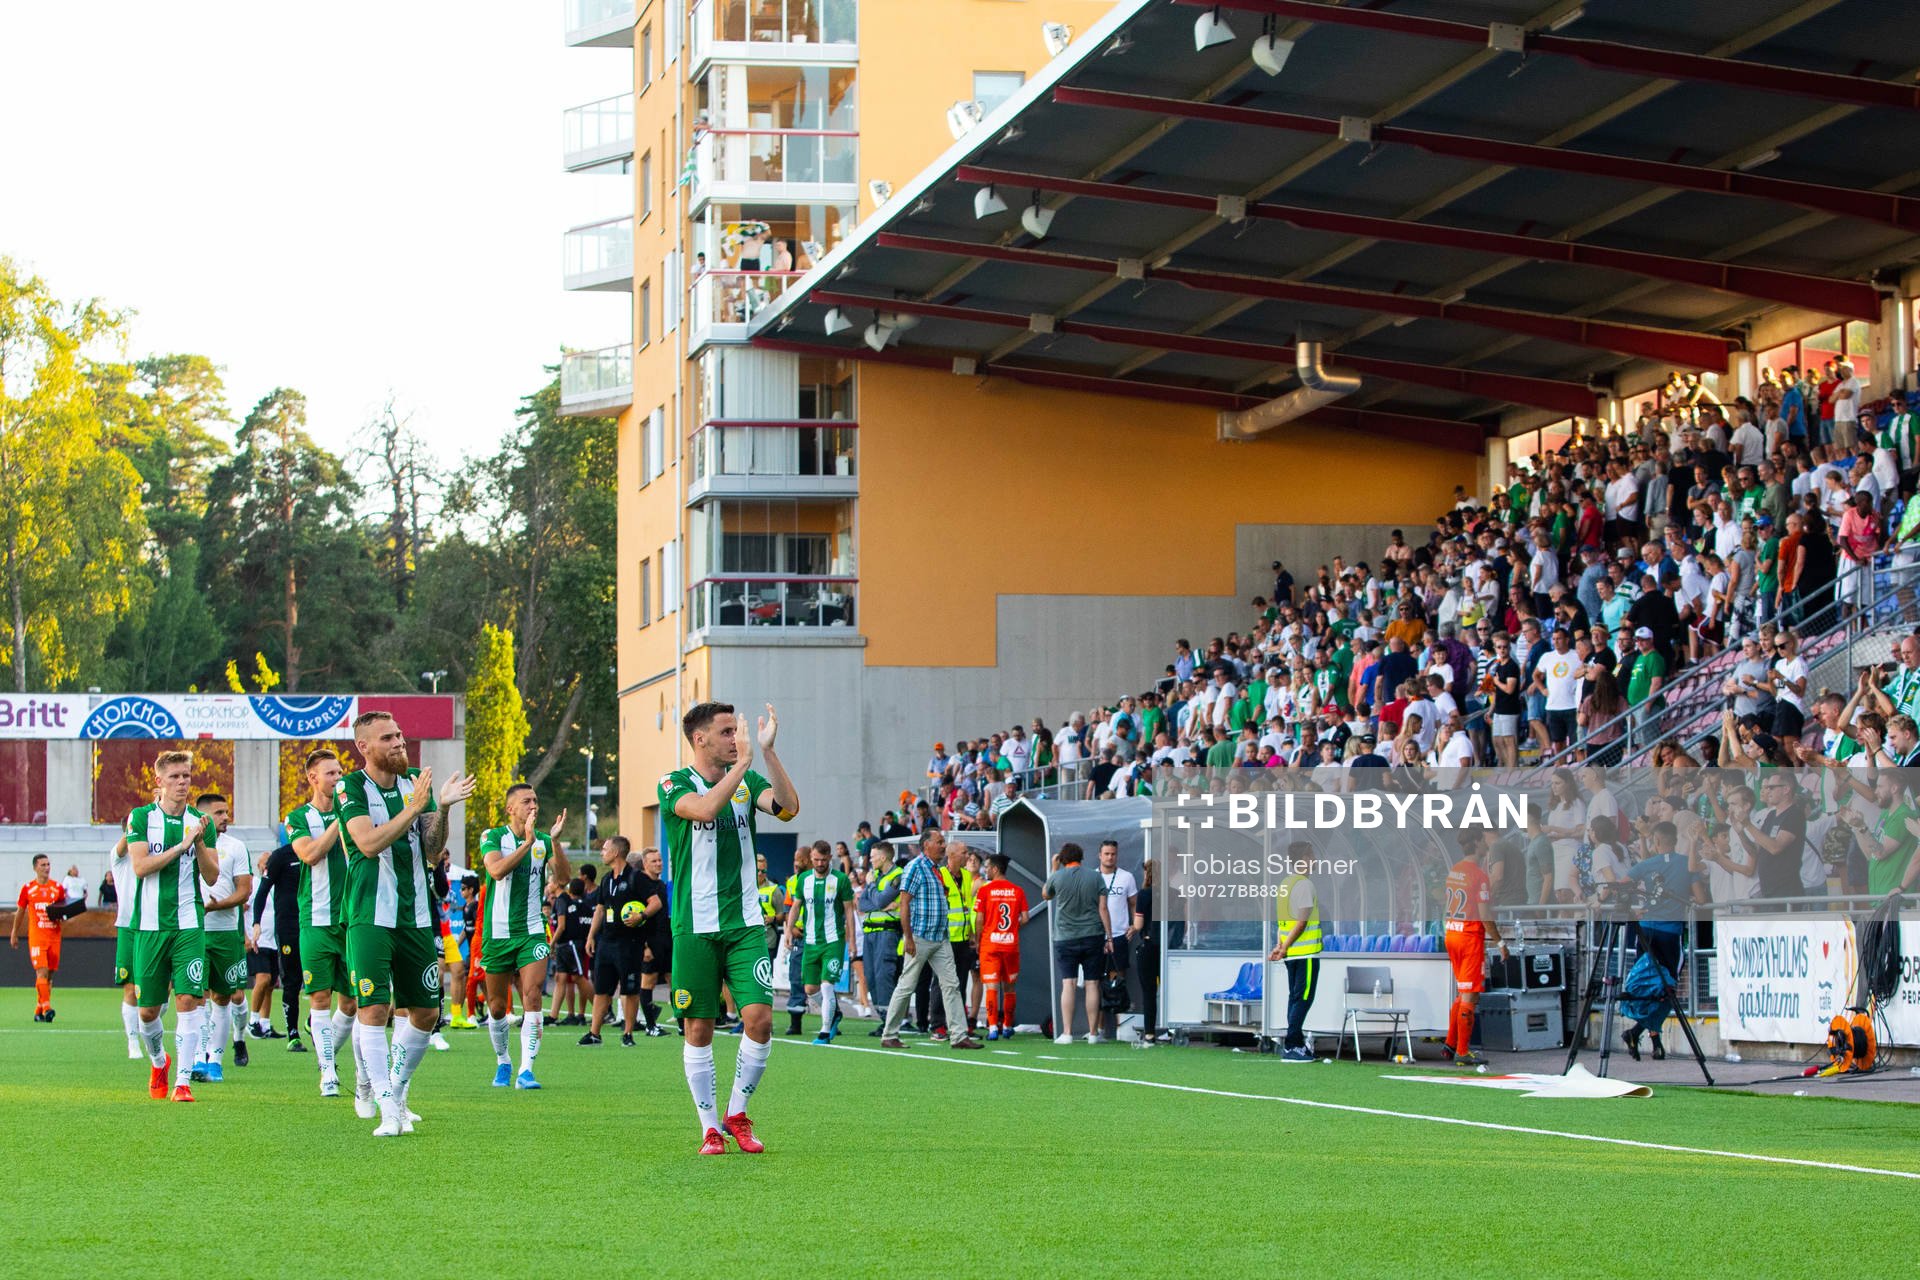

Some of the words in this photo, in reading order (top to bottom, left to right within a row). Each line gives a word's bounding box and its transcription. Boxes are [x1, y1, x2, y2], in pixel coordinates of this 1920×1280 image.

[87, 701, 177, 738] CHOPCHOP
[185, 706, 249, 719] CHOPCHOP
[254, 696, 294, 730] ASIAN
[998, 902, 1012, 931] 3
[1730, 935, 1809, 978] SUNDBYHOLMS
[321, 1027, 333, 1062] Clinton
